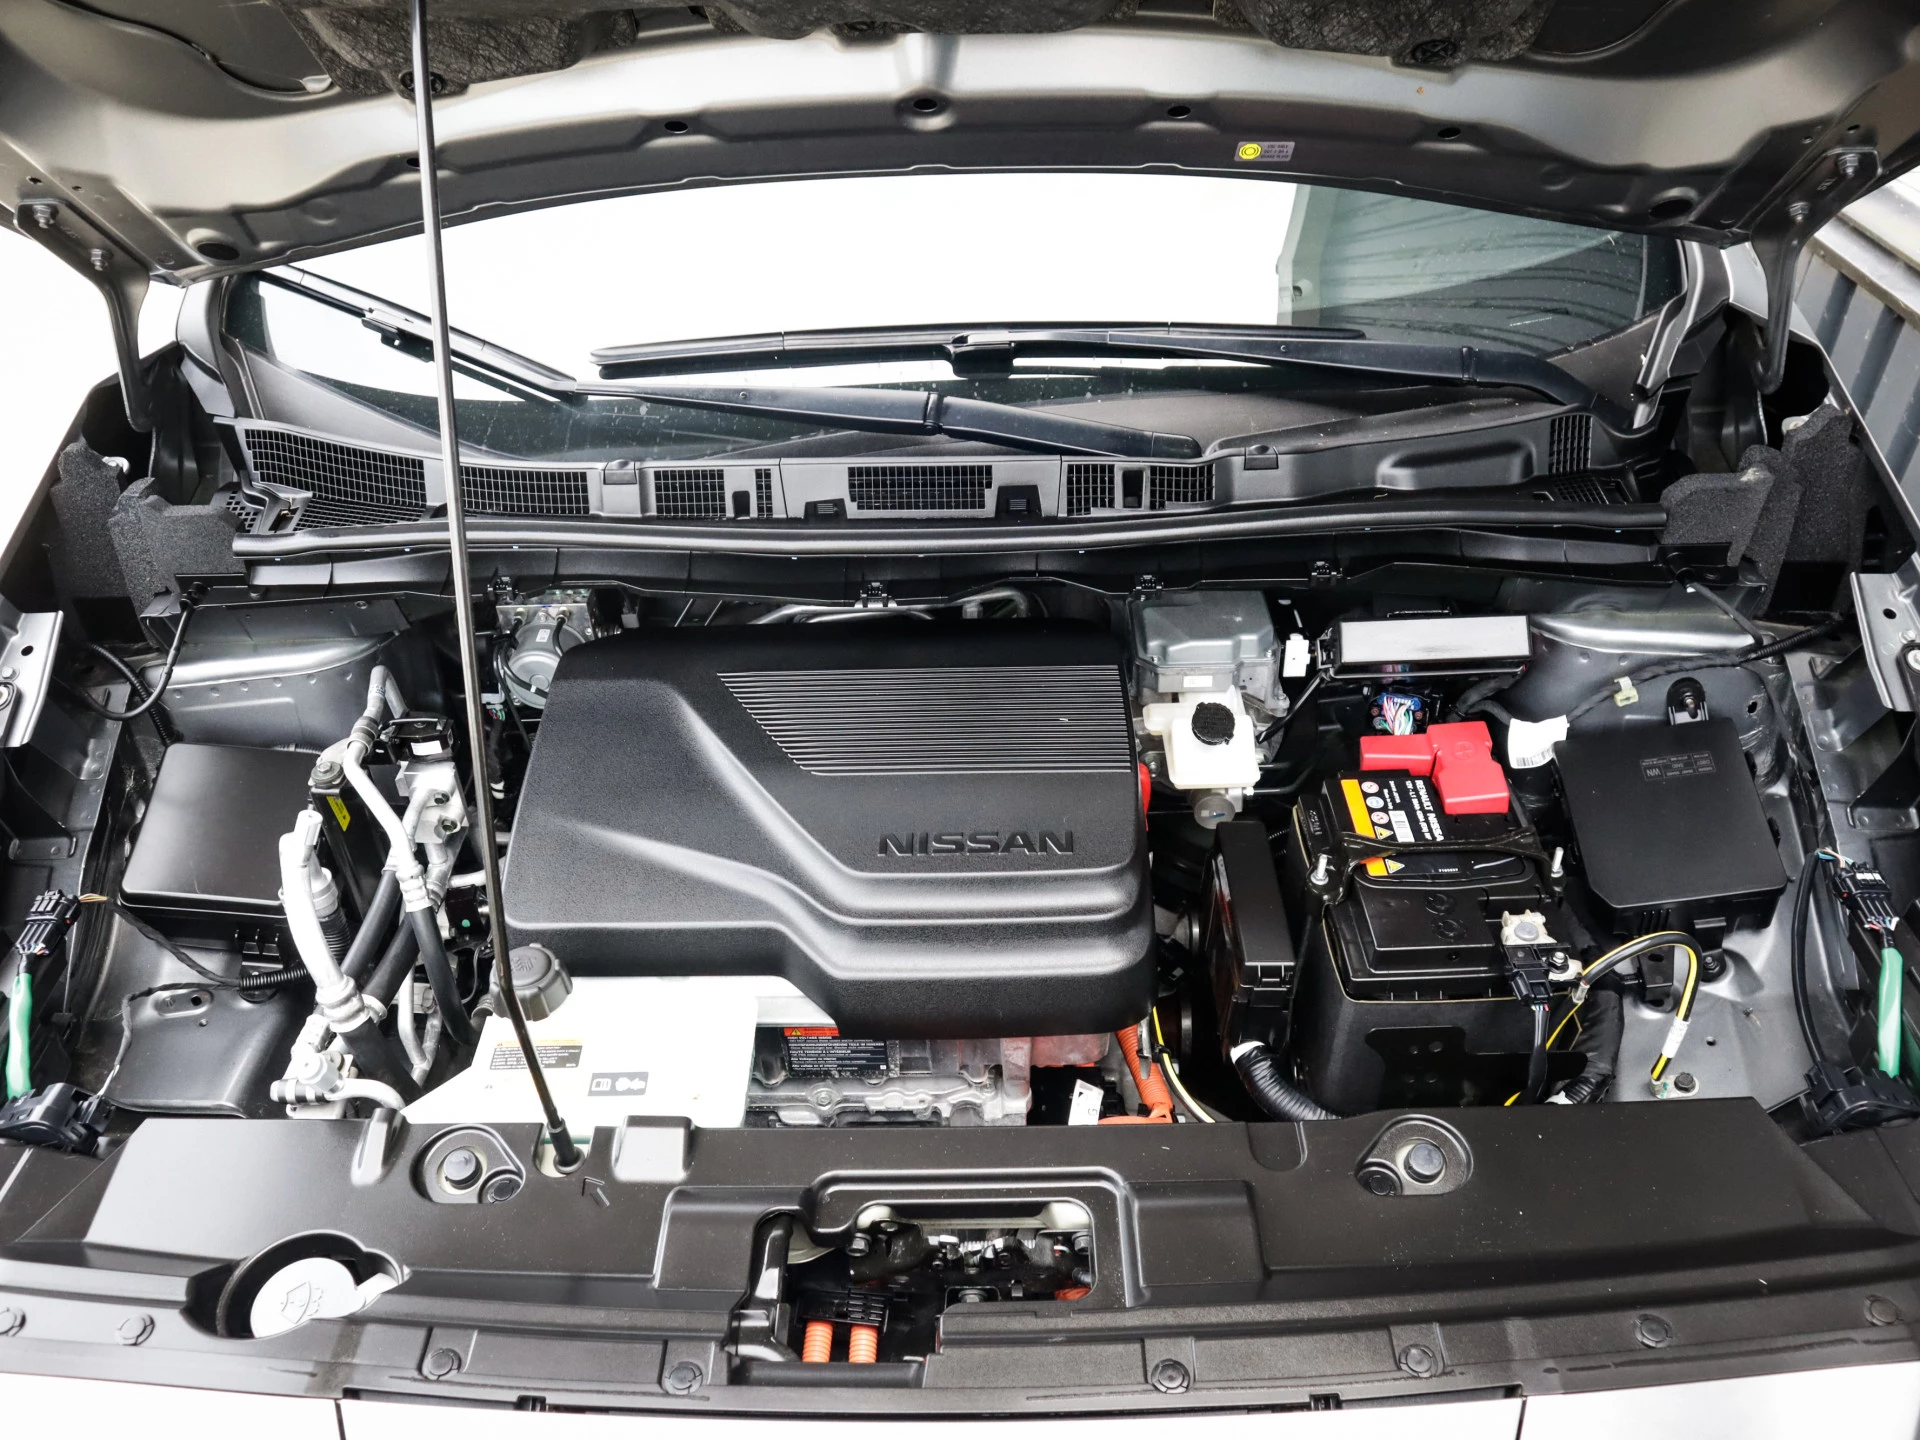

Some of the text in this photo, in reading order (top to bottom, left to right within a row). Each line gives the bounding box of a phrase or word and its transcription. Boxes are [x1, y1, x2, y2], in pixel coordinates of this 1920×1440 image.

[1415, 780, 1444, 841] RENAULT NISSA
[878, 830, 1073, 856] NISSAN
